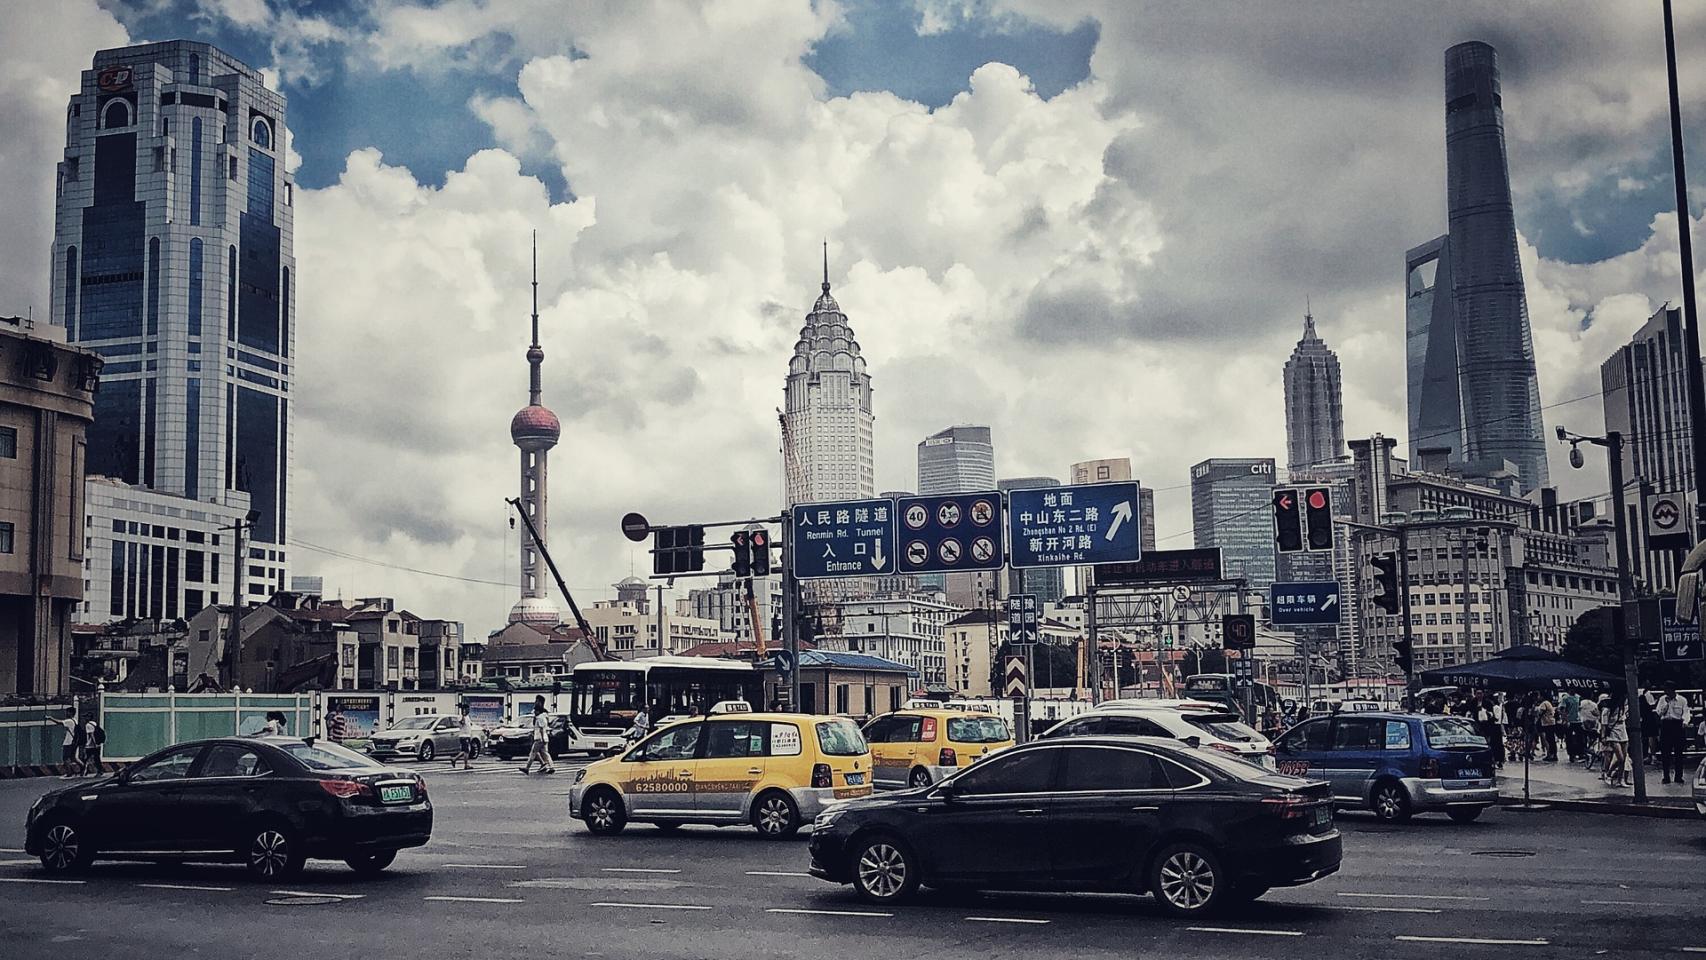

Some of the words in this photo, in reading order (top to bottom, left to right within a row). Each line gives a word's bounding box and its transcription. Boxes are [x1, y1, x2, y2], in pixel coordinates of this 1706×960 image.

[1251, 462, 1272, 474] citi
[1043, 492, 1073, 507] 地面
[800, 507, 887, 526] 人民路隧道
[909, 511, 924, 522] 40
[1020, 507, 1099, 525] 中山东二路
[806, 530, 834, 540] Renmin
[856, 527, 884, 537] Tunnel
[1023, 525, 1056, 536] Zhongshan
[1069, 525, 1073, 533] 2
[1087, 523, 1097, 532] (E)
[1029, 534, 1092, 552] 新开河路
[822, 543, 866, 557] 入口
[1038, 553, 1070, 562] Xinkaihe
[826, 561, 862, 571] Entrance
[1231, 623, 1247, 637] 40
[1453, 676, 1479, 686] POLICE
[1565, 679, 1599, 688] POLICE
[635, 783, 688, 792] 62580000
